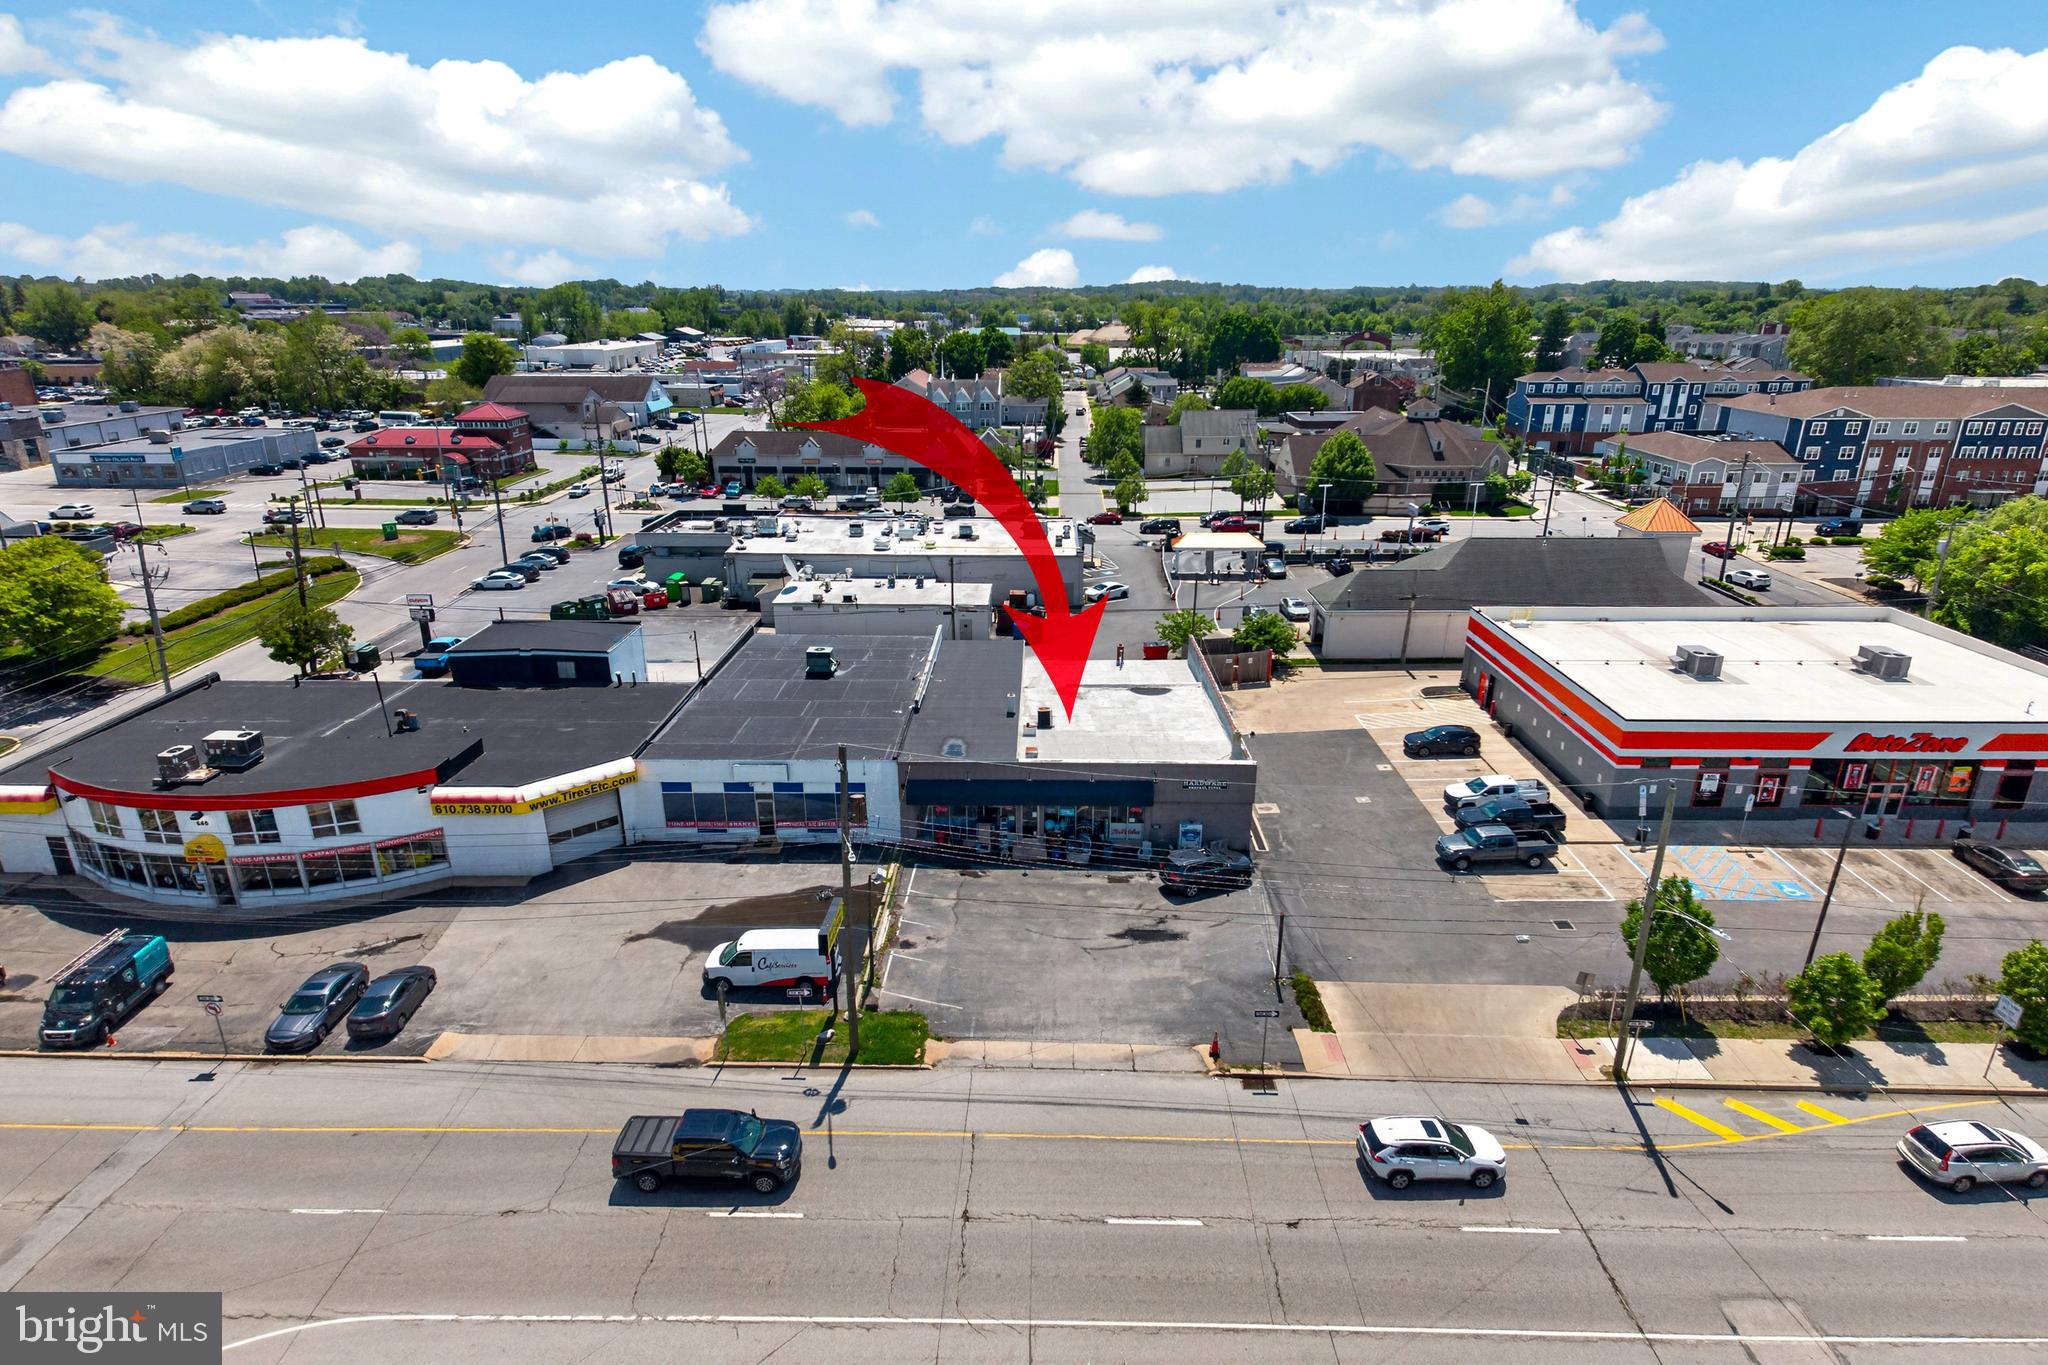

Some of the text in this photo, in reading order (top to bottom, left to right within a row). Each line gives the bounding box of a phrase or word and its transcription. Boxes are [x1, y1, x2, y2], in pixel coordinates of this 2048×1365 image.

[1843, 732, 1969, 753] AutoZone
[528, 775, 637, 812] www.TiresEtc.com
[435, 804, 513, 815] 610.738.9700
